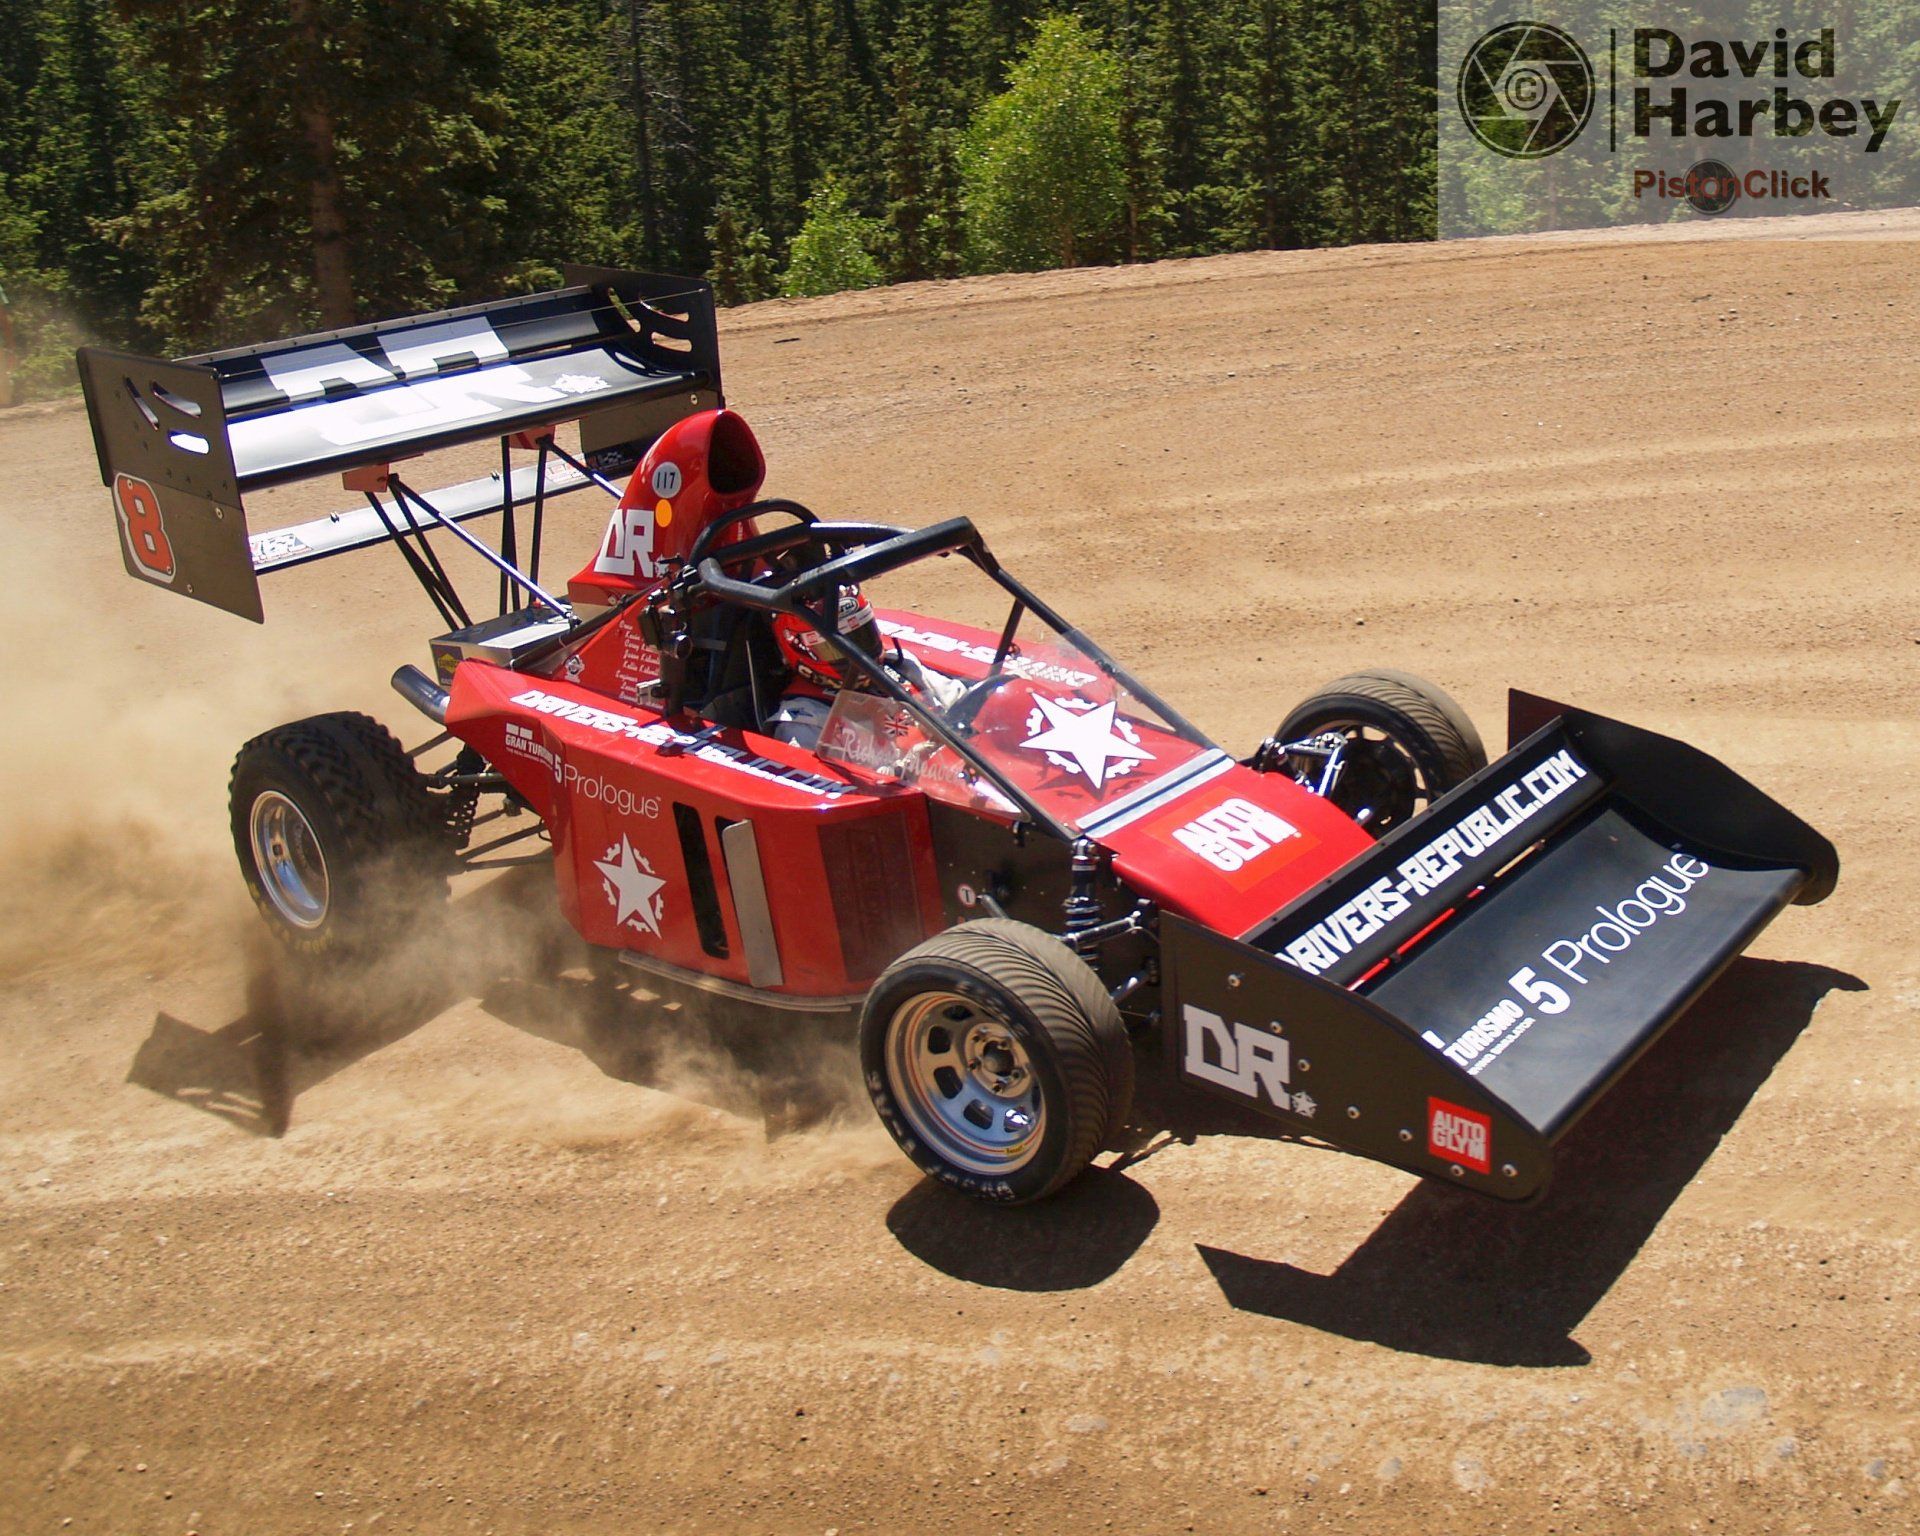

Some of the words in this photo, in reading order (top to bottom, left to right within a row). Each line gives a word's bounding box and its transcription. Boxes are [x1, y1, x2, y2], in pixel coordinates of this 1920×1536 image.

[656, 472, 676, 489] 117
[114, 473, 176, 583] 8
[593, 508, 655, 578] DR
[505, 734, 527, 750] GRAN
[554, 753, 562, 784] 5
[564, 763, 660, 819] Prologue
[1508, 966, 1571, 1015] 5
[1541, 853, 1709, 985] Prologue
[1183, 1003, 1291, 1111] DR
[1443, 998, 1524, 1067] TURISMO
[1433, 1110, 1486, 1142] AUTO
[1433, 1126, 1486, 1162] GLYM
